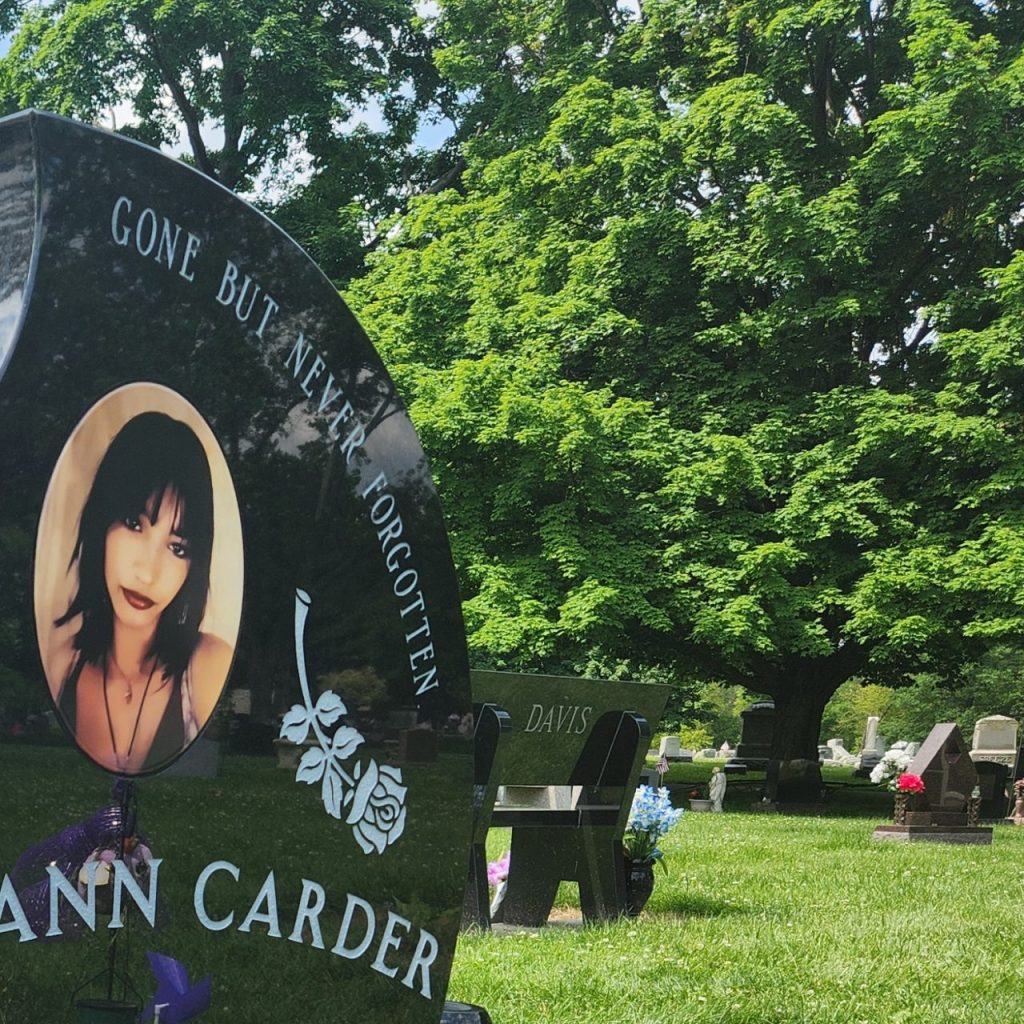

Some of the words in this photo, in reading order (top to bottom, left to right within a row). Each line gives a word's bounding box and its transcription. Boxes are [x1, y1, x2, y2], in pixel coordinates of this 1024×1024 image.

[111, 196, 201, 282] GONE
[215, 259, 279, 338] BUT
[283, 333, 367, 464] NEVER
[361, 470, 440, 697] FORGOTTEN
[524, 704, 593, 735] DAVIS
[193, 860, 440, 998] CARDER
